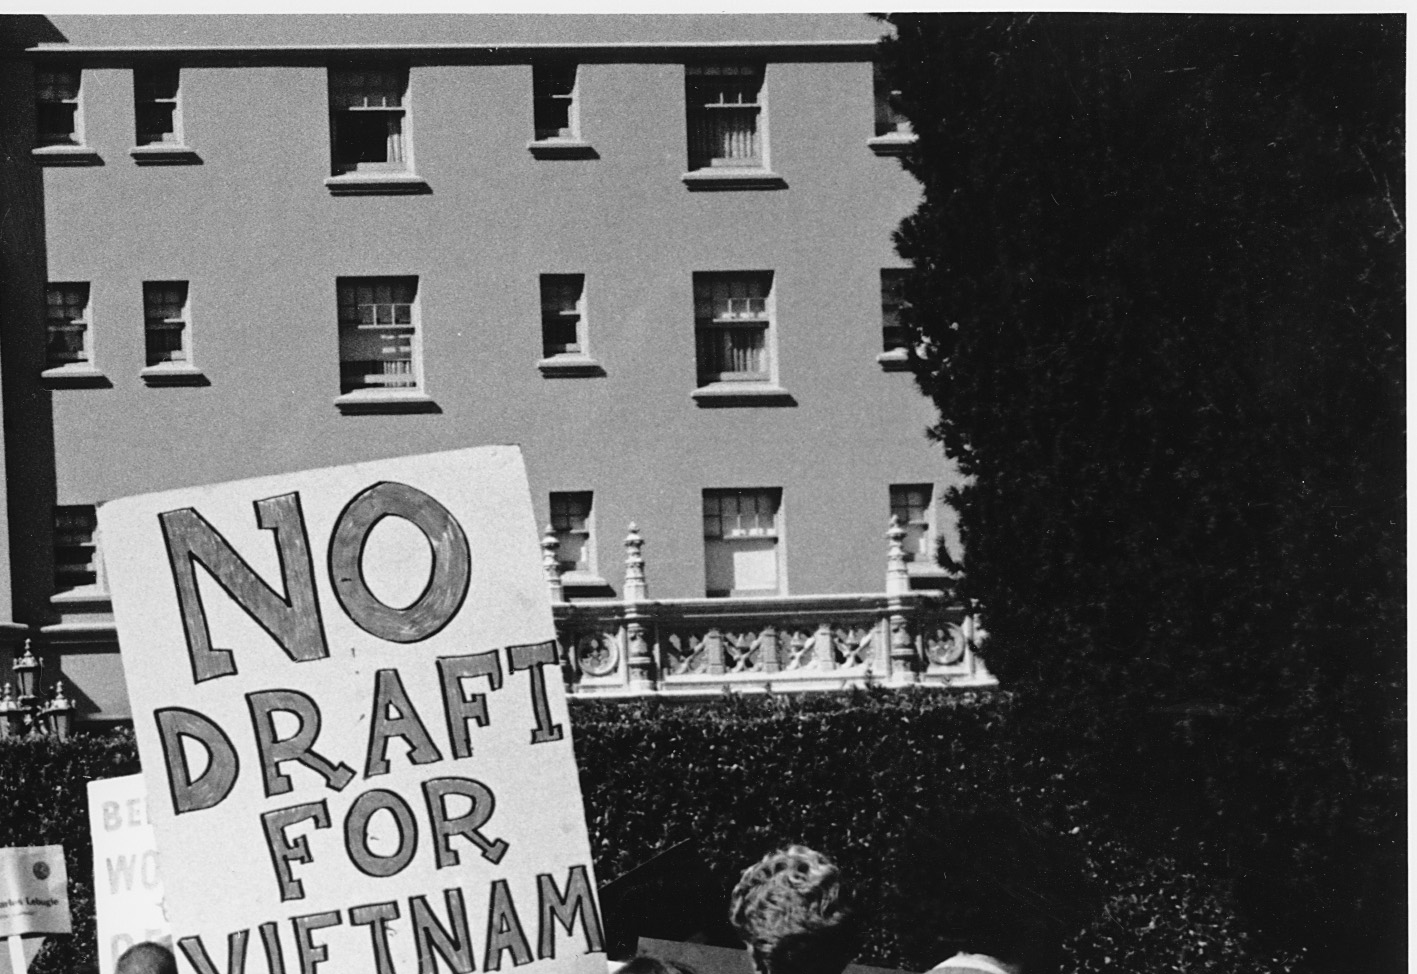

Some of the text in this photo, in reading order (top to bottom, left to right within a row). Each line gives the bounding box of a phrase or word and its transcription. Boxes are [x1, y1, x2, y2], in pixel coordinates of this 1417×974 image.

[157, 481, 472, 684] NO
[153, 640, 563, 815] DRAFT
[101, 797, 145, 833] BE
[260, 776, 509, 903] FOR
